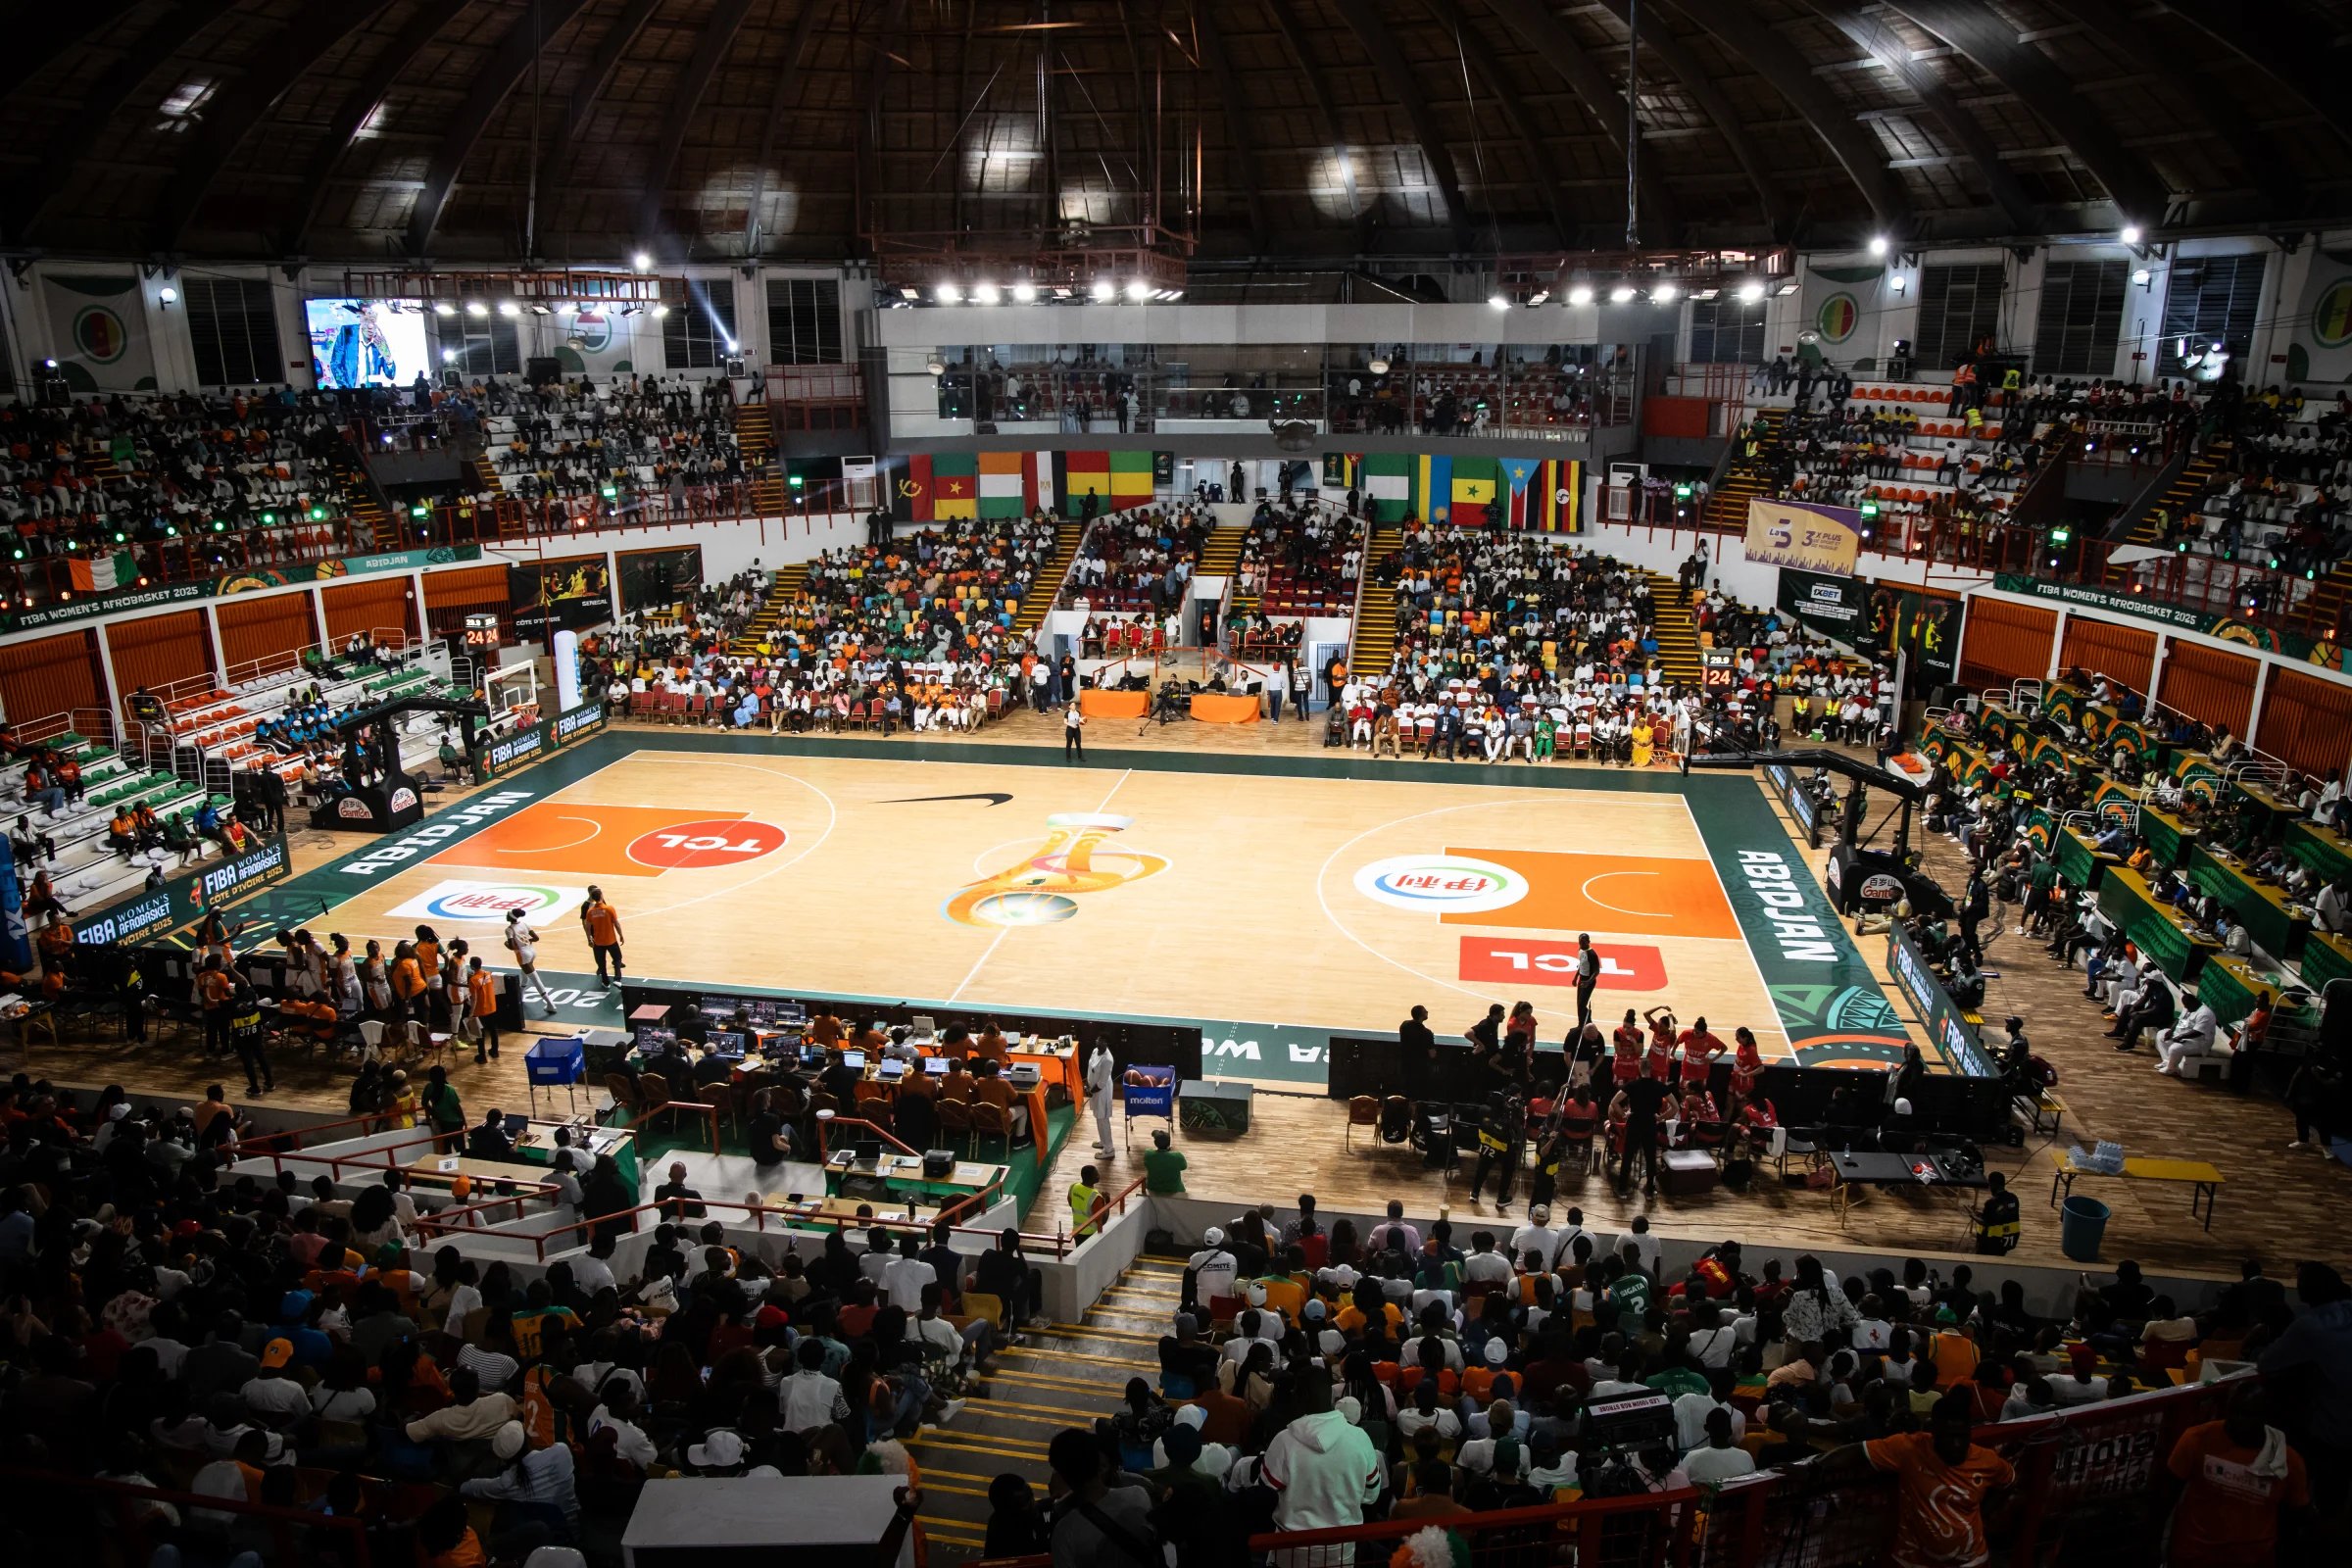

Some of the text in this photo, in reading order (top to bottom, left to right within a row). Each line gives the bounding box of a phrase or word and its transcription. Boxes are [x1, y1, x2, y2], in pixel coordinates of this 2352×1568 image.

[1801, 530, 1816, 547] 3
[1823, 533, 1842, 542] PLUS
[366, 555, 409, 568] ABIDJAN
[1813, 588, 1839, 599] 1XBET
[2036, 583, 2197, 625] FIBA WOMEN'S AFROBASKET 2025
[20, 586, 199, 626] FIBA WOMEN'S AFROBASKET 2025
[467, 628, 498, 644] 24 24
[1710, 656, 1730, 664] 29.9
[1708, 669, 1731, 685] 24
[559, 714, 576, 736] FIBA
[513, 730, 541, 747] WOMEN'S
[492, 743, 513, 765] FIBA
[339, 792, 535, 875] ABIDJAN
[656, 834, 763, 853] TCL
[237, 843, 281, 869] WOMEN'S
[239, 852, 282, 879] AFROBASKET
[205, 863, 237, 896] FIBA
[209, 864, 284, 905] CÔTE D'IVOIRE 2025
[1396, 874, 1489, 892] 伊利
[1869, 877, 1896, 887] 百岁山
[117, 893, 170, 923] WOMEN'S
[448, 894, 541, 910] 伊利
[1738, 850, 1838, 962] ABIDJAN
[119, 903, 171, 936] AFROBASKET
[152, 916, 173, 933] 2025
[77, 918, 117, 945] FIBA
[1491, 951, 1636, 976] TCL
[522, 986, 611, 1007] 202
[1946, 1018, 1965, 1063] FIBA
[1619, 1282, 1645, 1298] SIGATA
[1630, 1296, 1647, 1314] 2
[1598, 1403, 1620, 1412] STROBE
